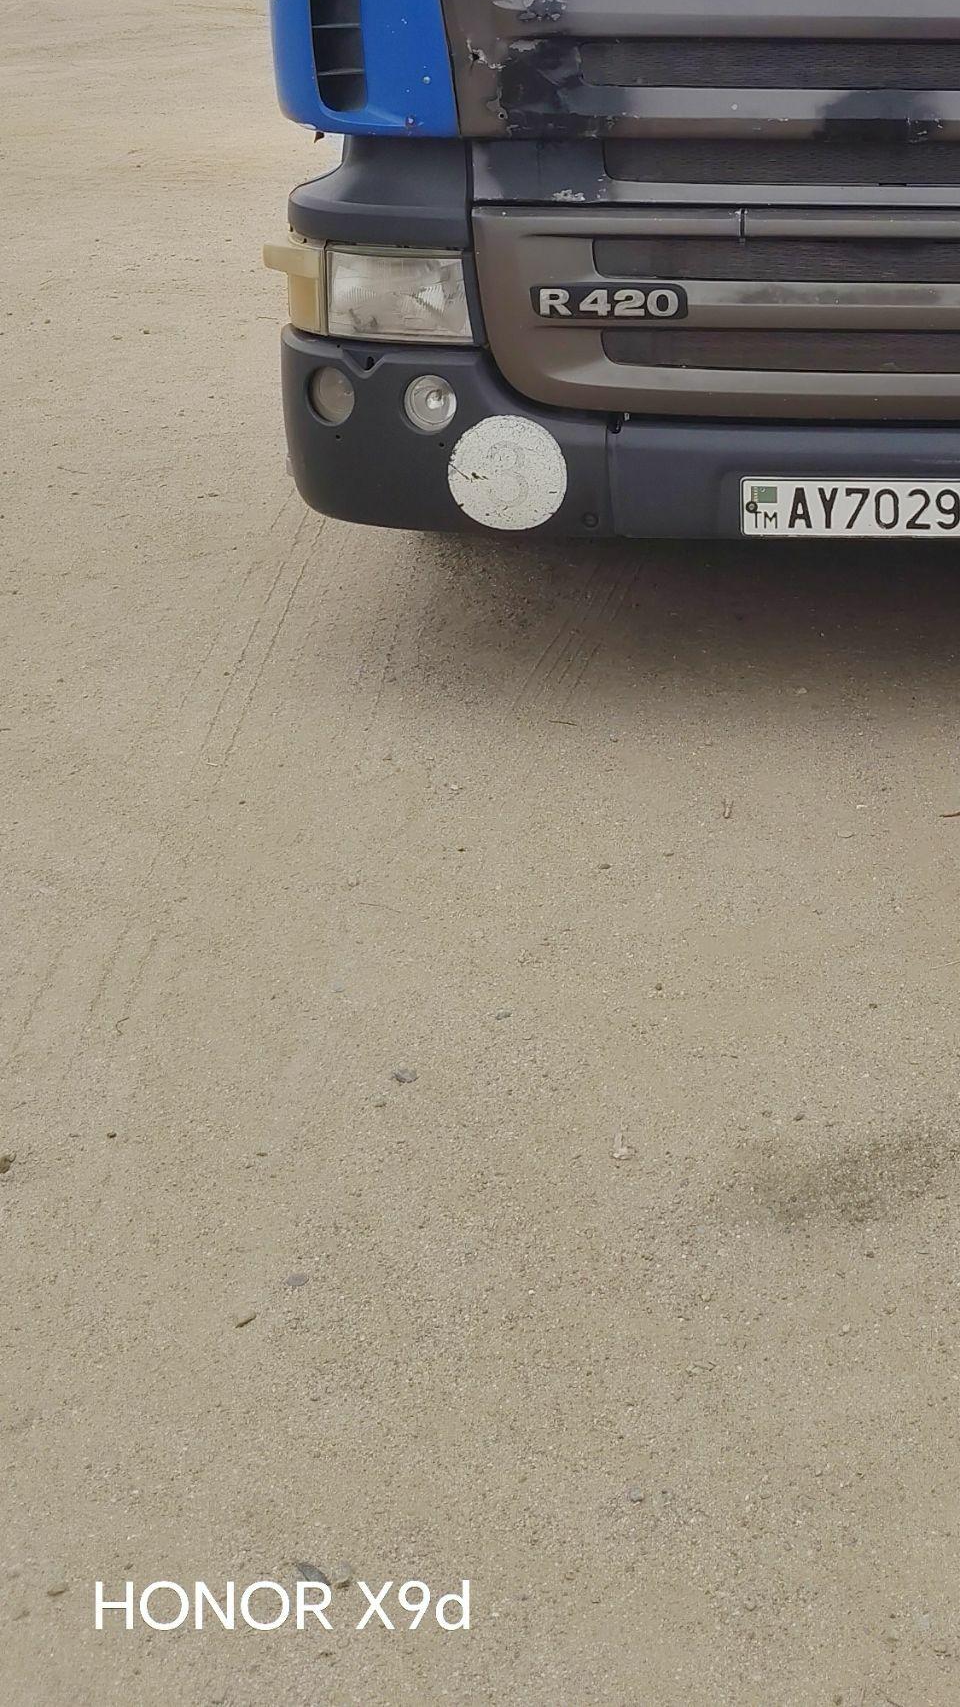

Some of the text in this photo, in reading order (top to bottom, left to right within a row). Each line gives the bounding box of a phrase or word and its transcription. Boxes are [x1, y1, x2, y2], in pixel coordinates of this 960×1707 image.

[539, 288, 679, 317] R 420
[753, 510, 778, 530] TM
